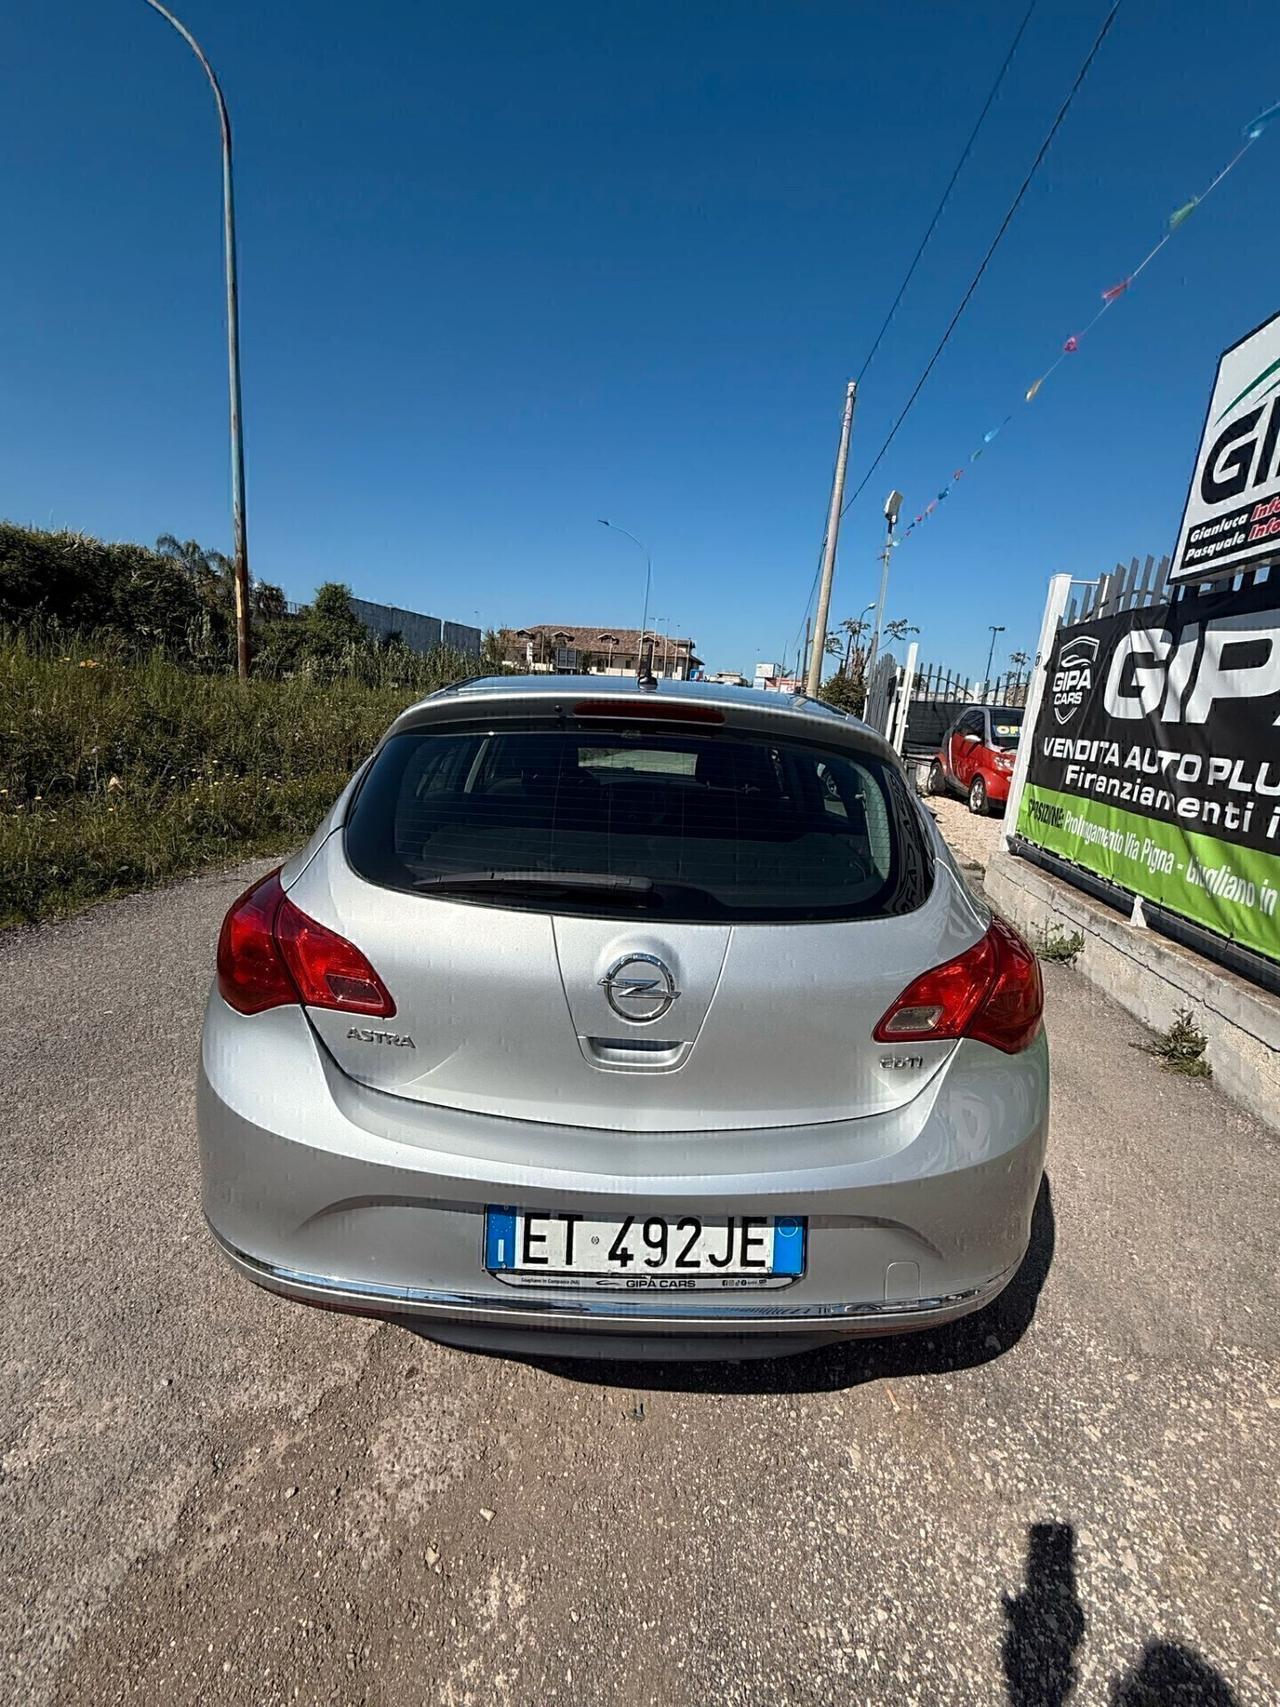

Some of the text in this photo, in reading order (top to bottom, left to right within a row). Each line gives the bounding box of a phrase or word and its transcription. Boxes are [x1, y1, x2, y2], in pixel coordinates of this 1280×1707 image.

[1201, 396, 1280, 505] GI
[1190, 513, 1248, 543] Gianluca
[1184, 531, 1246, 561] Pasquale
[1052, 668, 1091, 692] GIPA
[1104, 609, 1280, 726] GIP
[1054, 691, 1083, 705] CARS
[1043, 737, 1120, 767] VENDITA
[1123, 745, 1202, 783] AUTO
[1124, 831, 1140, 861] Via
[1140, 837, 1175, 875] Pigna
[1260, 878, 1278, 916] in
[347, 1027, 416, 1049] ASTRA
[522, 1211, 583, 1266] ET
[608, 1215, 767, 1268] 492JE
[626, 1279, 696, 1288] GIPA CARS
